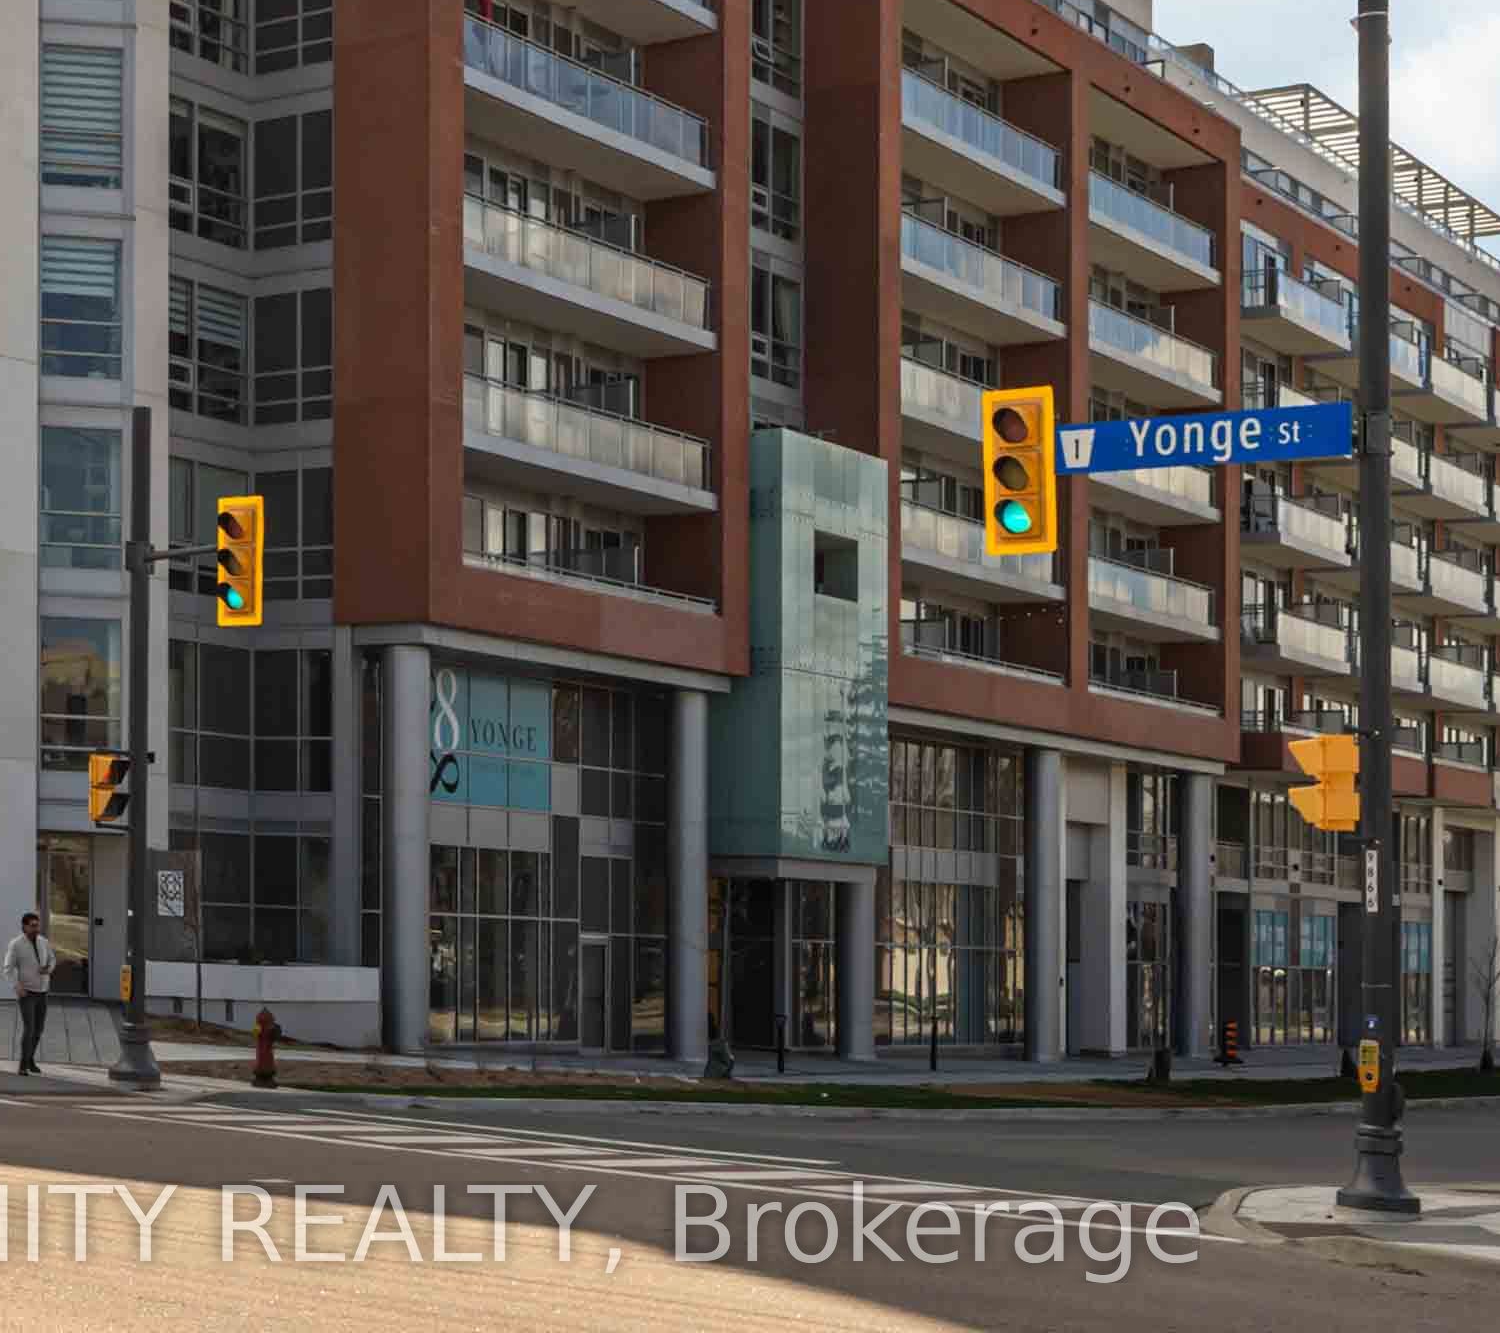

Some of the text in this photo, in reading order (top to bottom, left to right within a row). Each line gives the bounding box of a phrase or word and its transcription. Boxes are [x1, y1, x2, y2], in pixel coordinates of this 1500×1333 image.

[1129, 417, 1301, 462] Yonge St
[471, 719, 537, 751] YONGE
